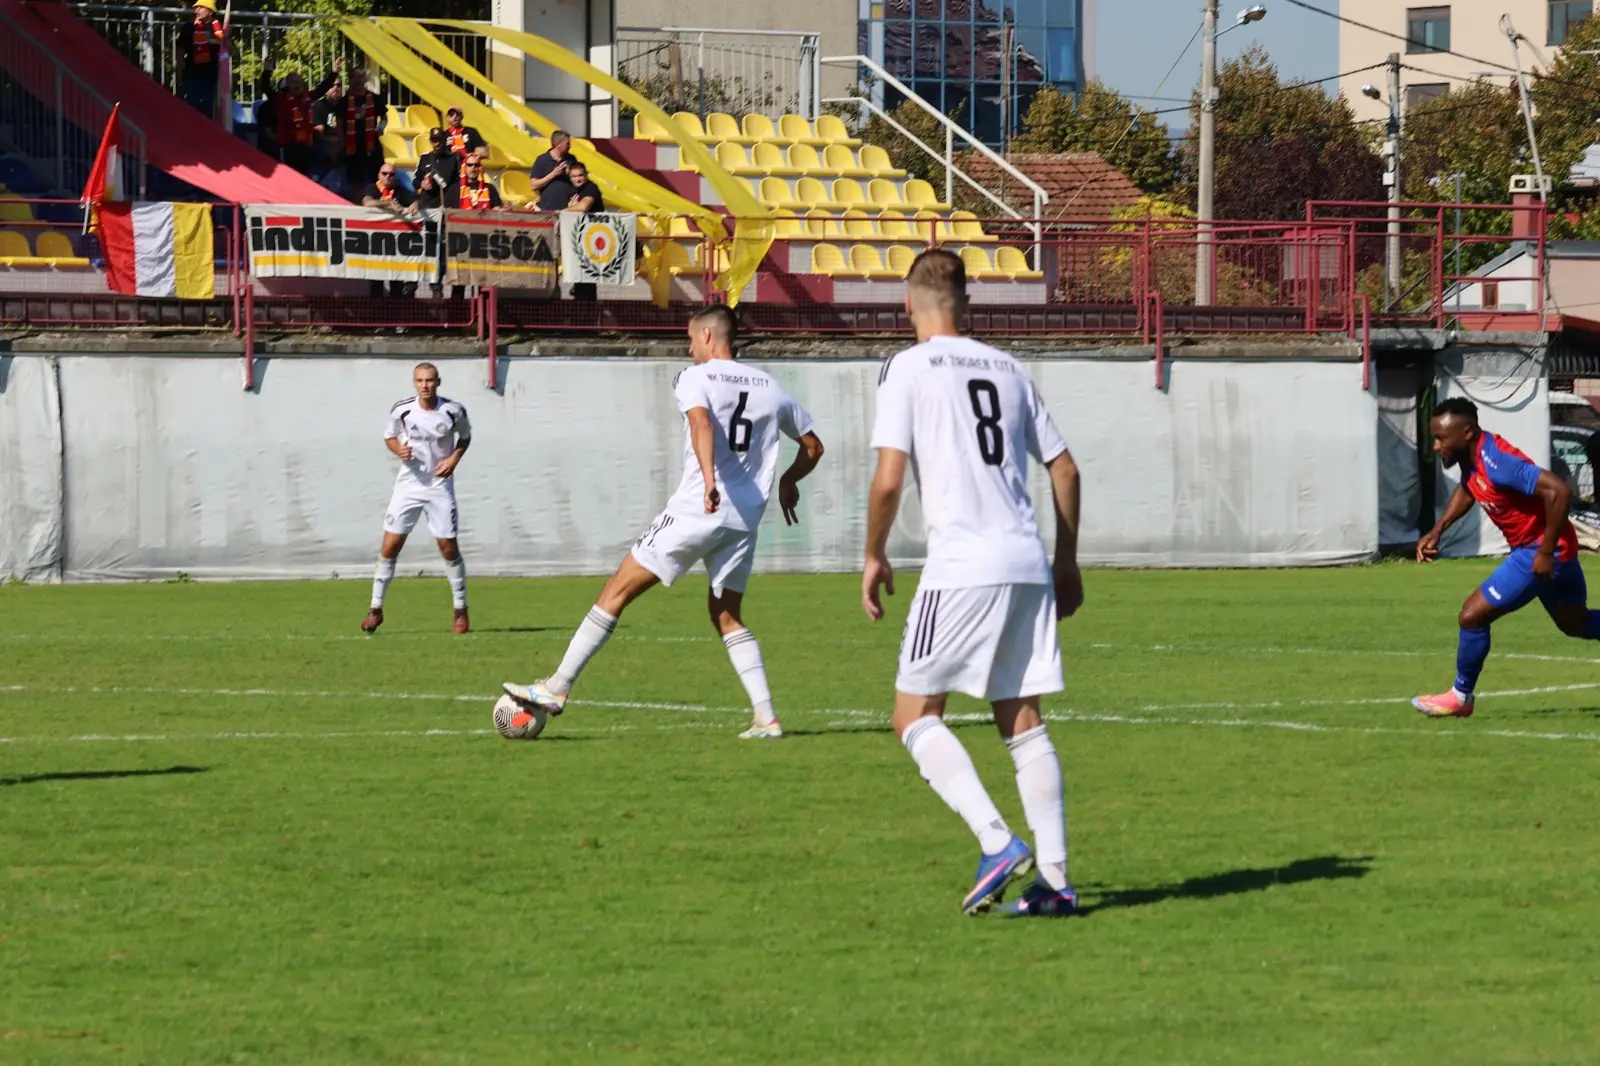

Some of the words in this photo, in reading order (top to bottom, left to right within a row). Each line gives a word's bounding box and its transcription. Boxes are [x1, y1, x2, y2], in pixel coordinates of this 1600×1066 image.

[251, 216, 438, 265] indijanci
[448, 230, 554, 261] PEŠČA
[719, 373, 749, 386] ZAGREB
[752, 377, 769, 388] CITY
[729, 391, 753, 452] 6
[967, 378, 1004, 466] 8
